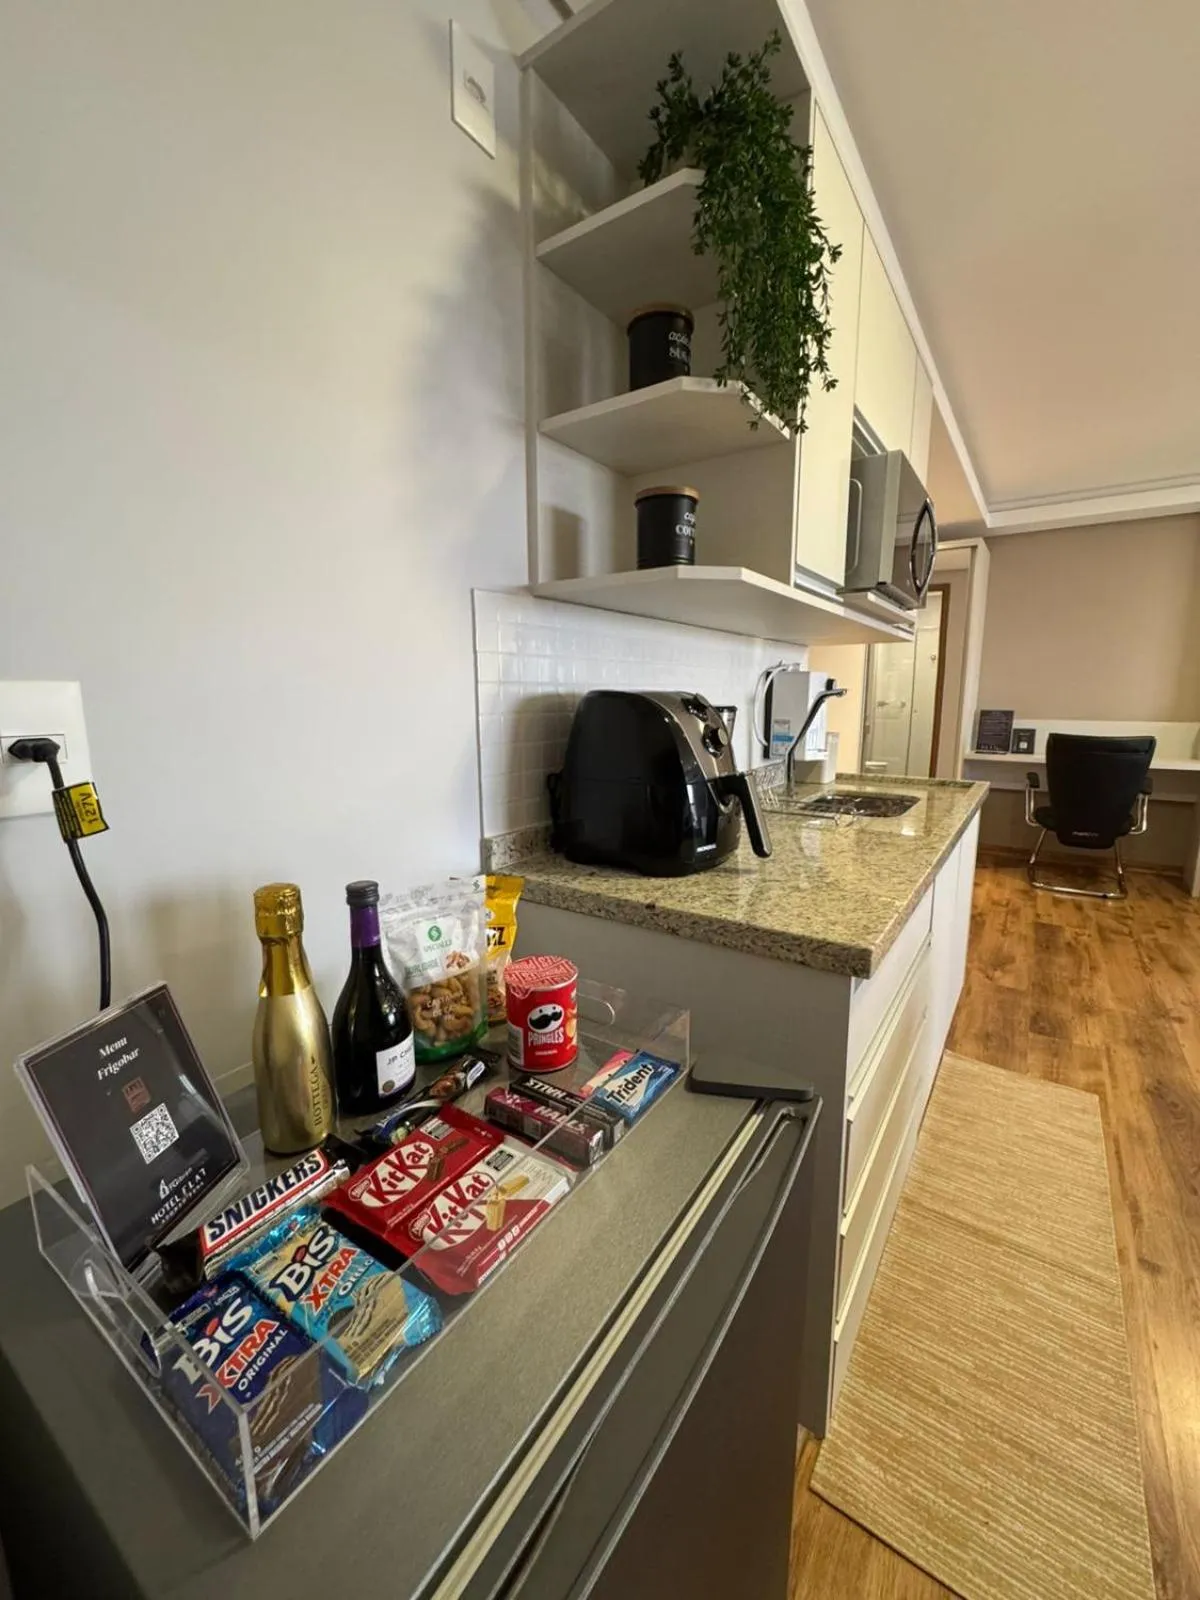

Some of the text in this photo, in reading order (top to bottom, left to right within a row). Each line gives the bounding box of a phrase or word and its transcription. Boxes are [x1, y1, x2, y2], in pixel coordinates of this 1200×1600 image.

[98, 1036, 128, 1058] Menu
[527, 1026, 565, 1047] PRINGLES
[97, 1047, 140, 1081] Frigobar
[605, 1062, 656, 1107] Trident
[524, 1076, 567, 1099] HALLS
[534, 1104, 589, 1135] HALLS
[366, 1141, 431, 1204] KitKat
[151, 1194, 181, 1225] HOTEL
[207, 1152, 322, 1242] SNICKERS
[427, 1173, 492, 1246] KitKat
[299, 1247, 361, 1318] XTRA
[195, 1318, 281, 1416] XTRA
[237, 1328, 290, 1392] ORIGINAL
